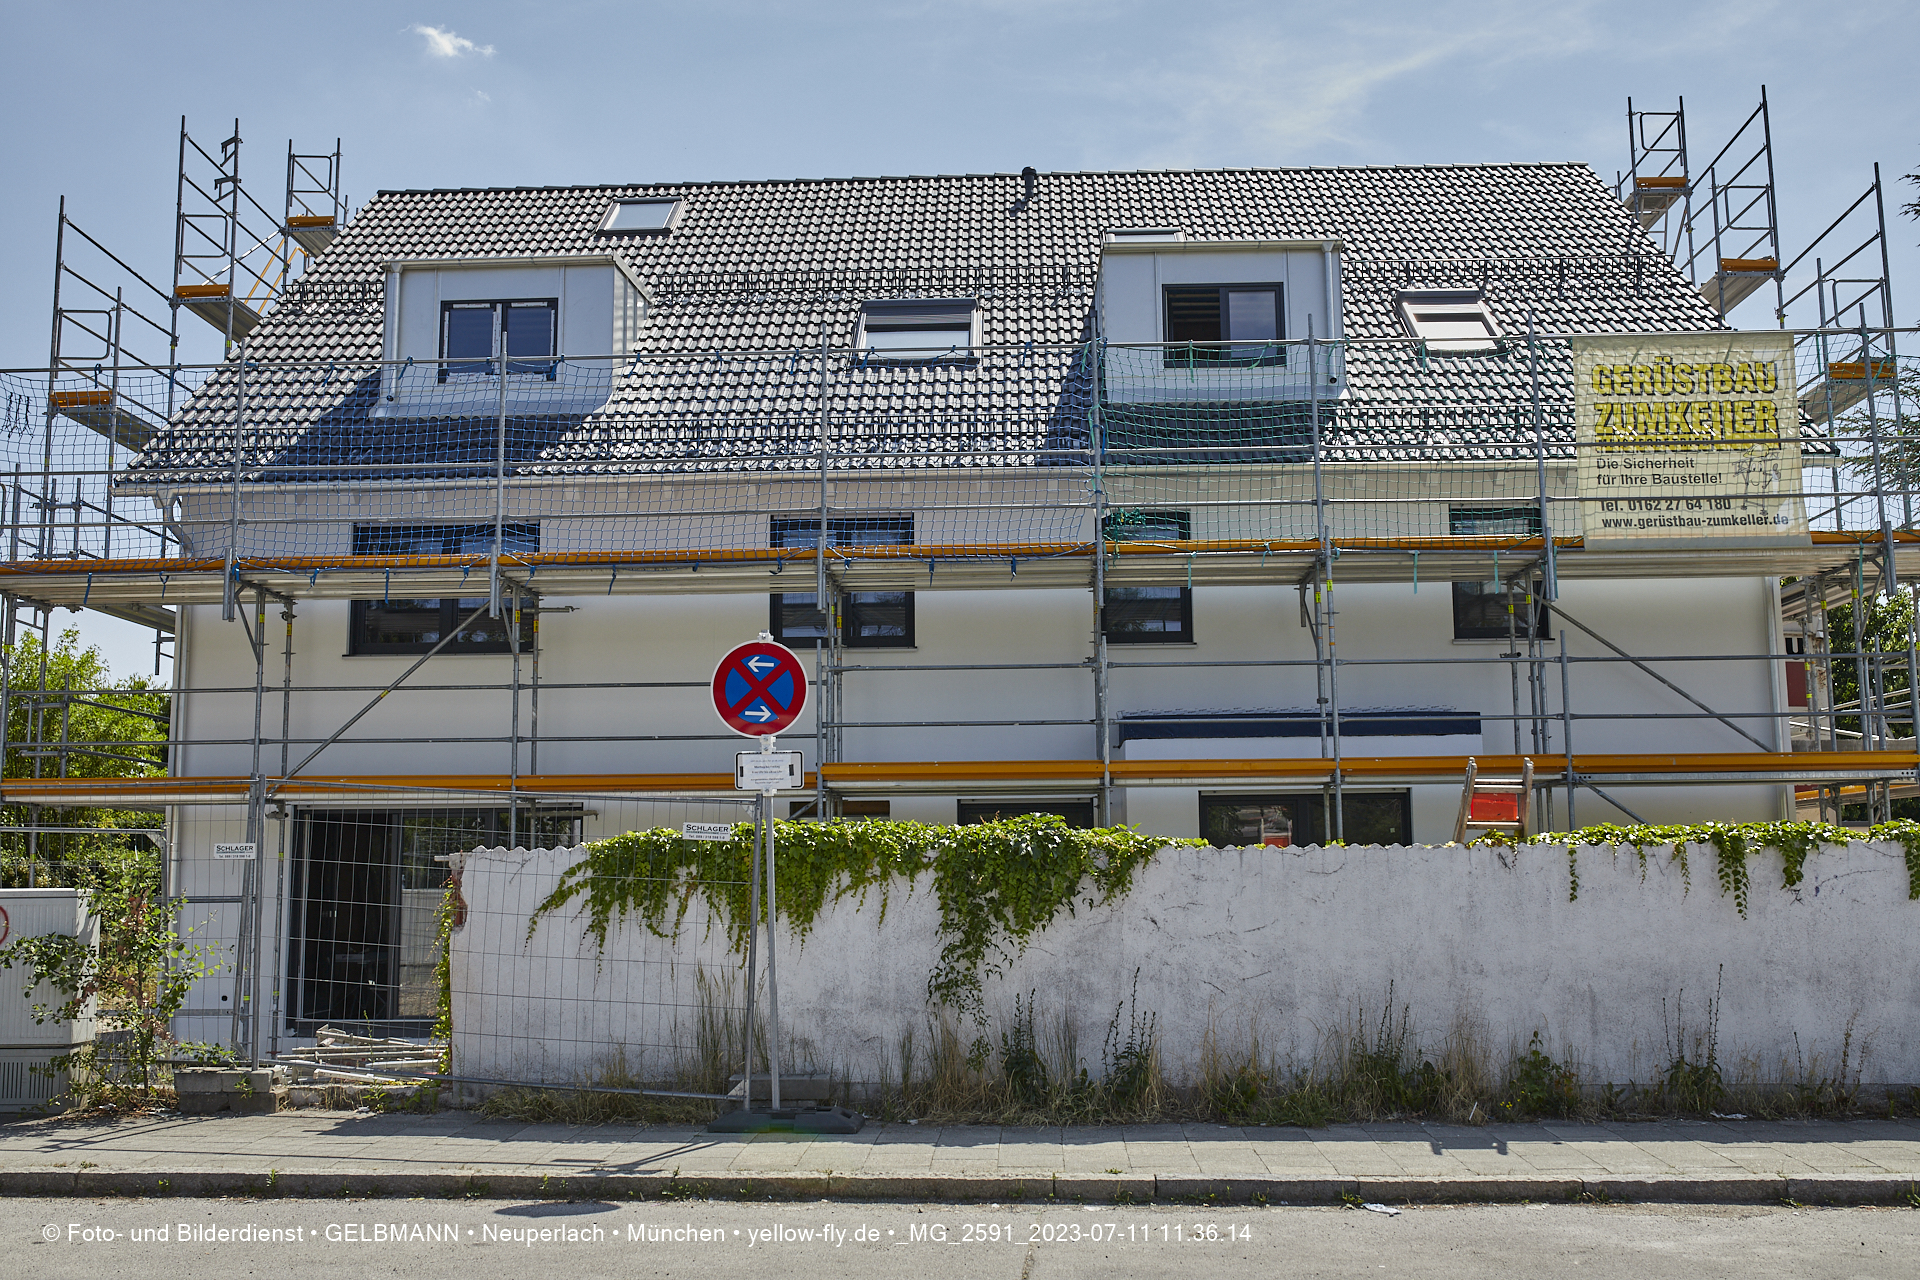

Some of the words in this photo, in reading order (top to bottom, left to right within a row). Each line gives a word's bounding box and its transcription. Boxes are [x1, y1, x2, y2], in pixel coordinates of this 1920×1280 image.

[1591, 355, 1779, 396] GERÜSTBAU
[1596, 458, 1619, 469] Die
[1623, 457, 1695, 469] Sicherheit
[1596, 474, 1617, 485] für
[1621, 474, 1648, 485] Ihre
[1652, 472, 1722, 485] Baustelle!
[1628, 499, 1662, 511] 0162
[1665, 499, 1682, 511] 27
[1685, 499, 1703, 511] 64
[1708, 498, 1732, 510] 180
[1601, 513, 1790, 530] www.gerüstbau-zumkeller.de
[686, 824, 729, 832] SCHLAGER
